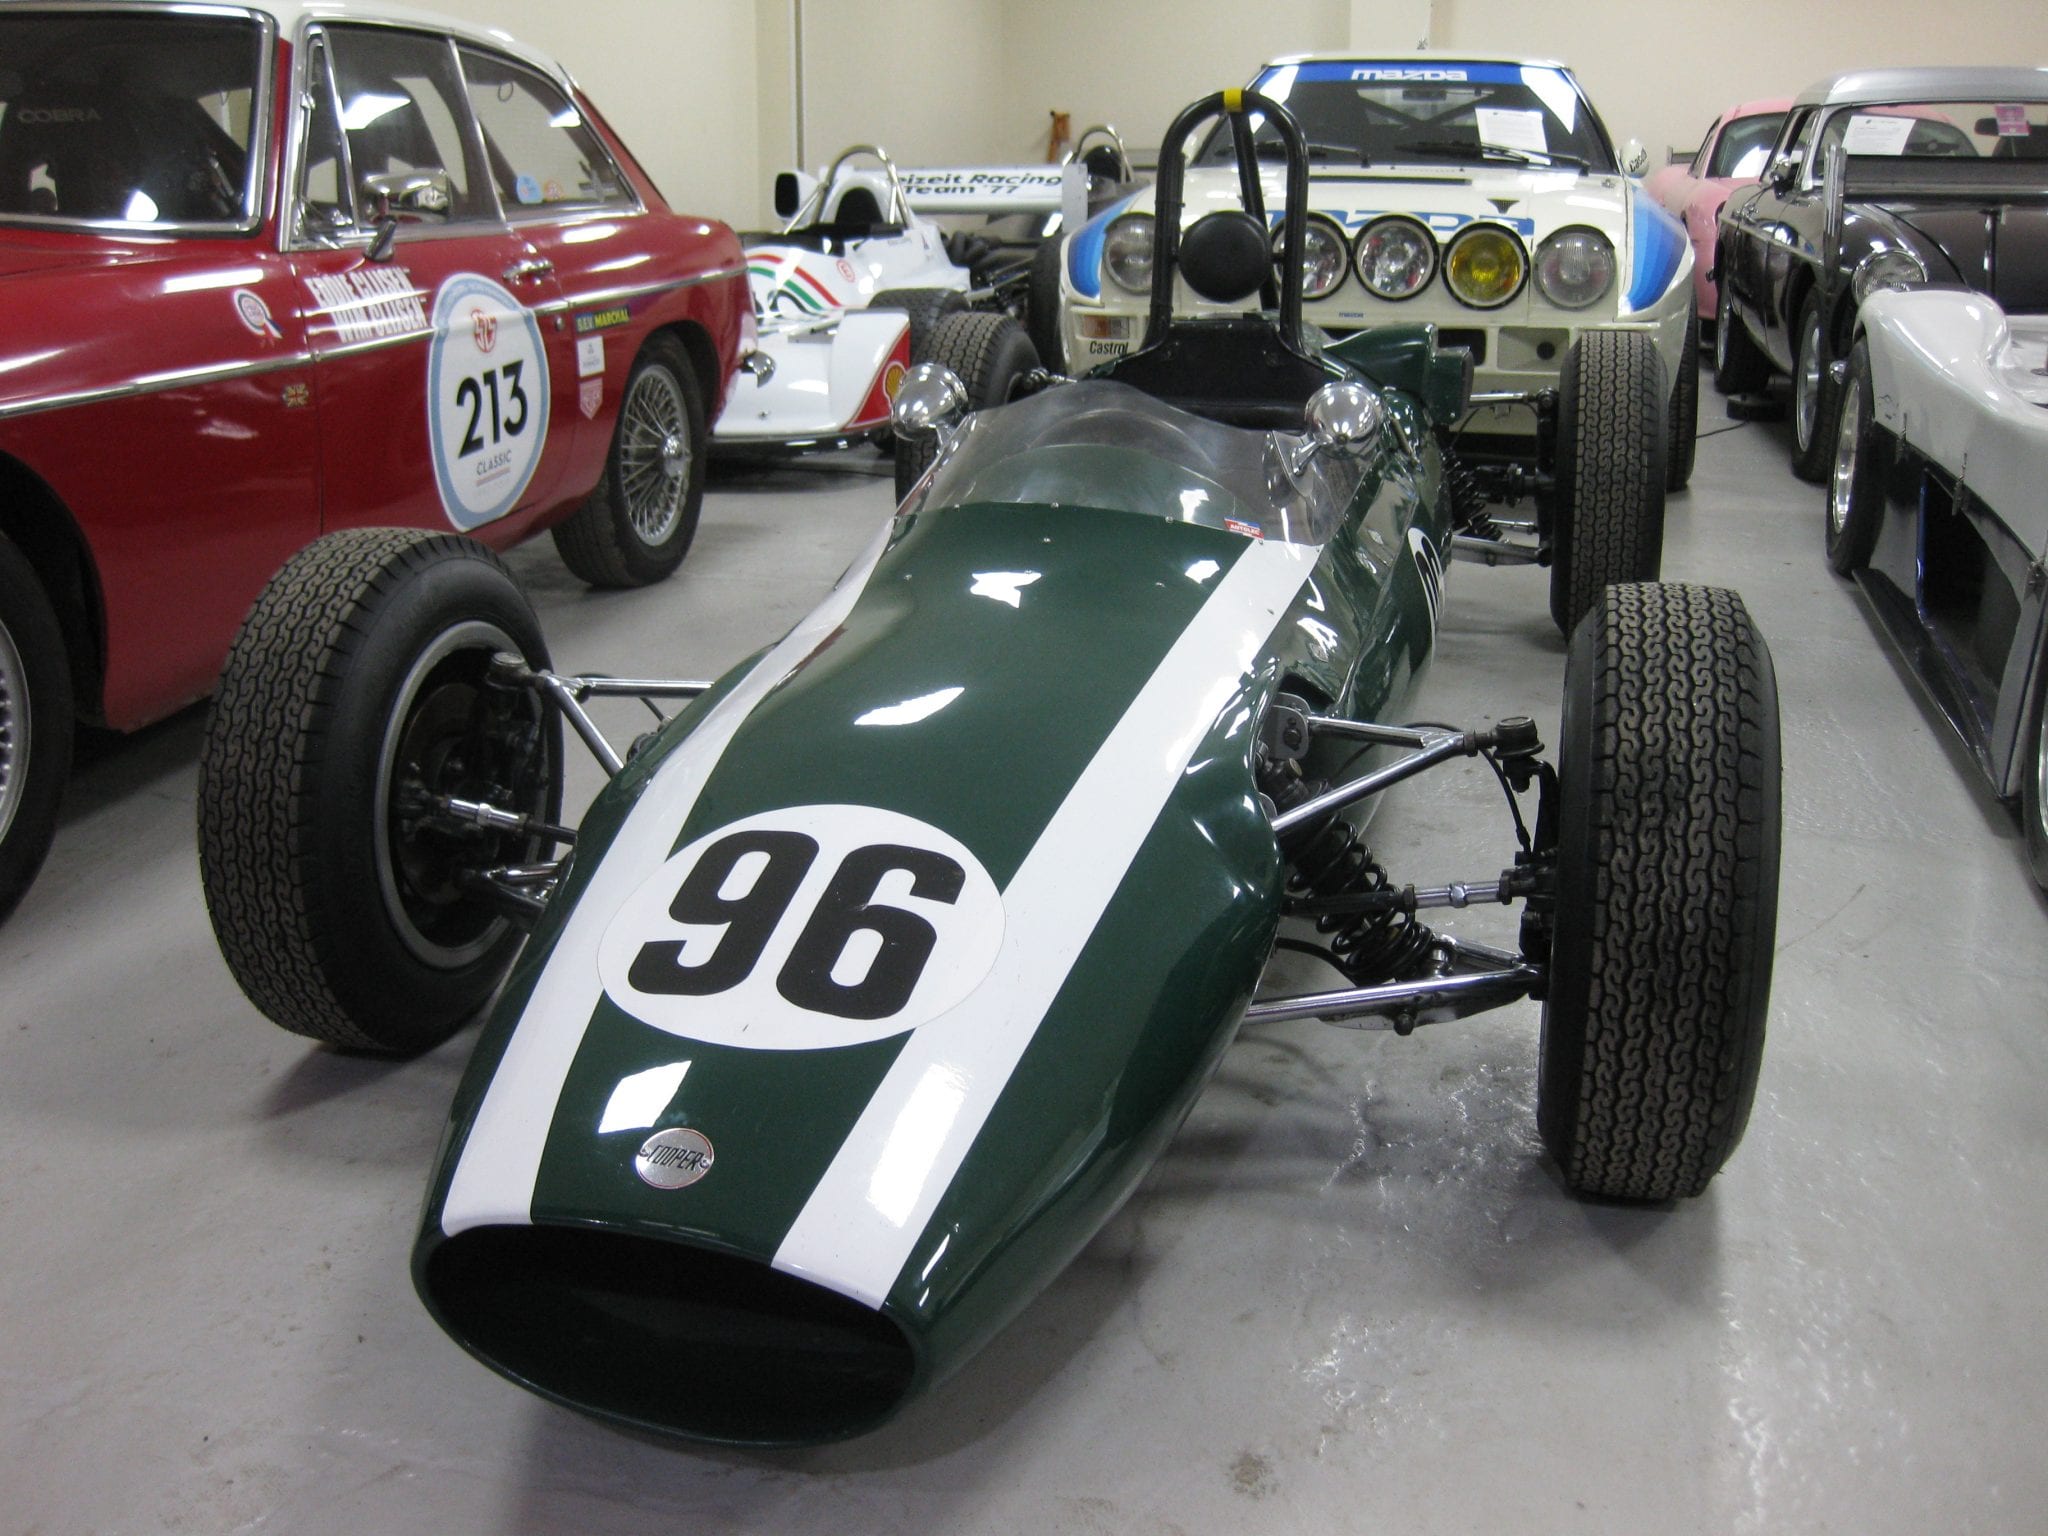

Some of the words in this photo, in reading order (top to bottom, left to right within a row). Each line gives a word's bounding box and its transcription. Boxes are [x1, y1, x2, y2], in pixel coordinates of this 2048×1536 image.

[1351, 69, 1468, 81] mazda
[905, 186, 975, 194] Team
[970, 173, 1062, 186] Racing
[1089, 341, 1129, 356] Castrol
[456, 359, 528, 460] 213
[476, 449, 513, 476] CLASSIC
[627, 829, 966, 1021] 96
[646, 1144, 704, 1171] COOPER
